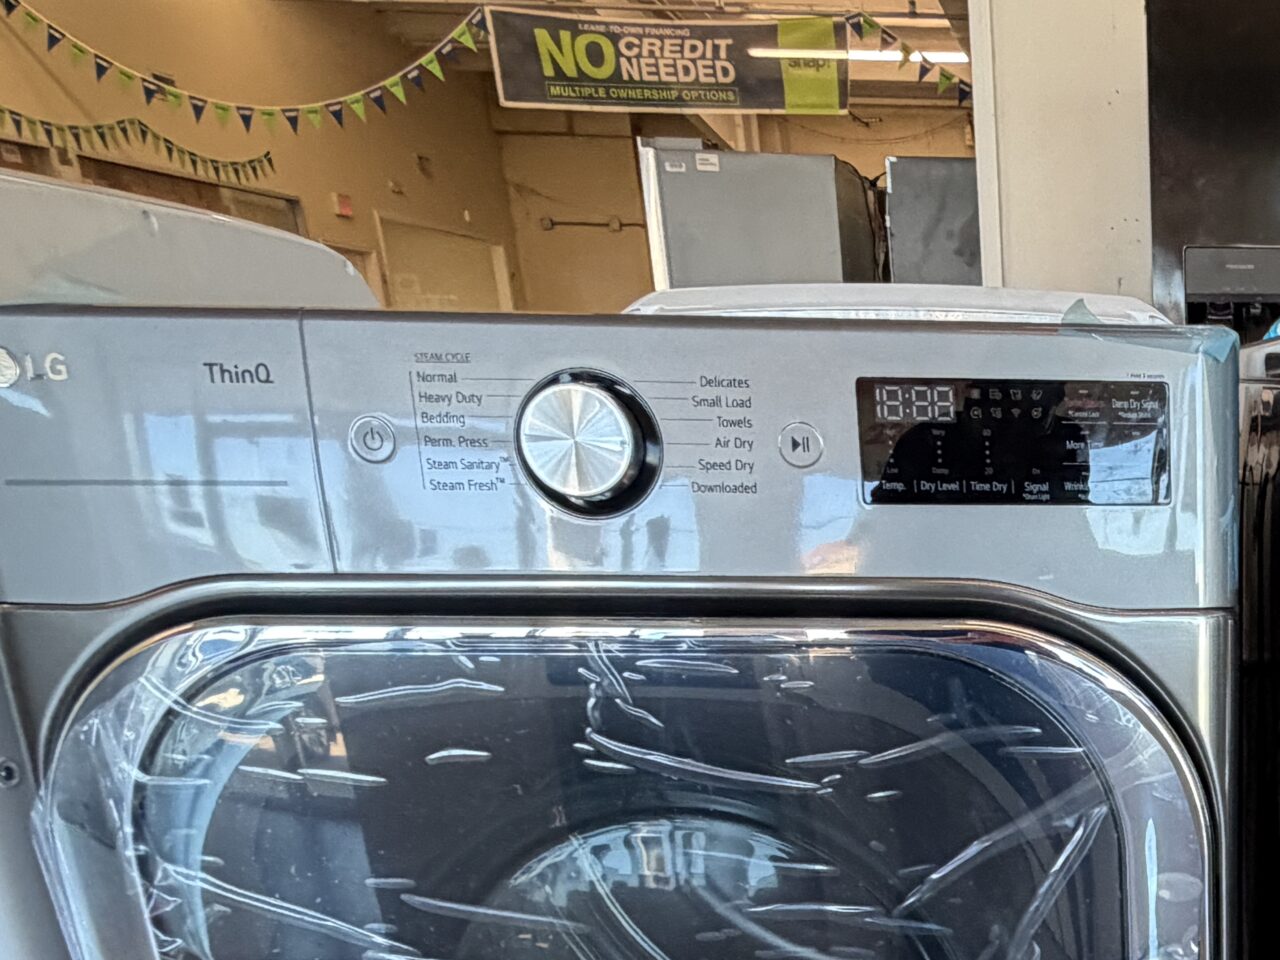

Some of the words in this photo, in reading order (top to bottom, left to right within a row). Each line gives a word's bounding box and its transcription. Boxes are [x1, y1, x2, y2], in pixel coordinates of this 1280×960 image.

[534, 27, 616, 80] NO
[618, 36, 733, 60] CREDIT
[619, 57, 736, 84] NEEDED
[549, 85, 607, 99] MULTIPLE
[609, 88, 679, 101] OWNERSHIP
[682, 89, 736, 102] OPTIONS
[414, 353, 444, 363] STEAM
[445, 353, 472, 363] CYCLE
[24, 352, 69, 381] LG
[203, 362, 275, 385] ThinQ
[416, 371, 458, 383] Normal
[700, 375, 750, 388] Delicates
[418, 391, 453, 406] Heavy
[456, 392, 483, 406] Duty
[691, 395, 723, 408] Small
[725, 396, 752, 408] Load
[421, 412, 466, 427] Bedding
[717, 416, 753, 428] Towels
[424, 435, 455, 447] Perm.
[458, 436, 488, 447] Press
[714, 437, 731, 448] Air
[734, 438, 754, 452] Dry
[1066, 440, 1085, 450] More
[426, 458, 458, 470] Steam
[698, 459, 732, 473] Speed
[735, 459, 755, 474] Dry
[430, 479, 465, 491] Steam
[692, 481, 758, 494] Downloaded
[881, 480, 906, 492] Temp.
[920, 481, 937, 493] Dry
[938, 481, 960, 491] Level
[970, 481, 991, 491] Time
[992, 481, 1008, 493] Dry
[1024, 481, 1049, 494] Signal
